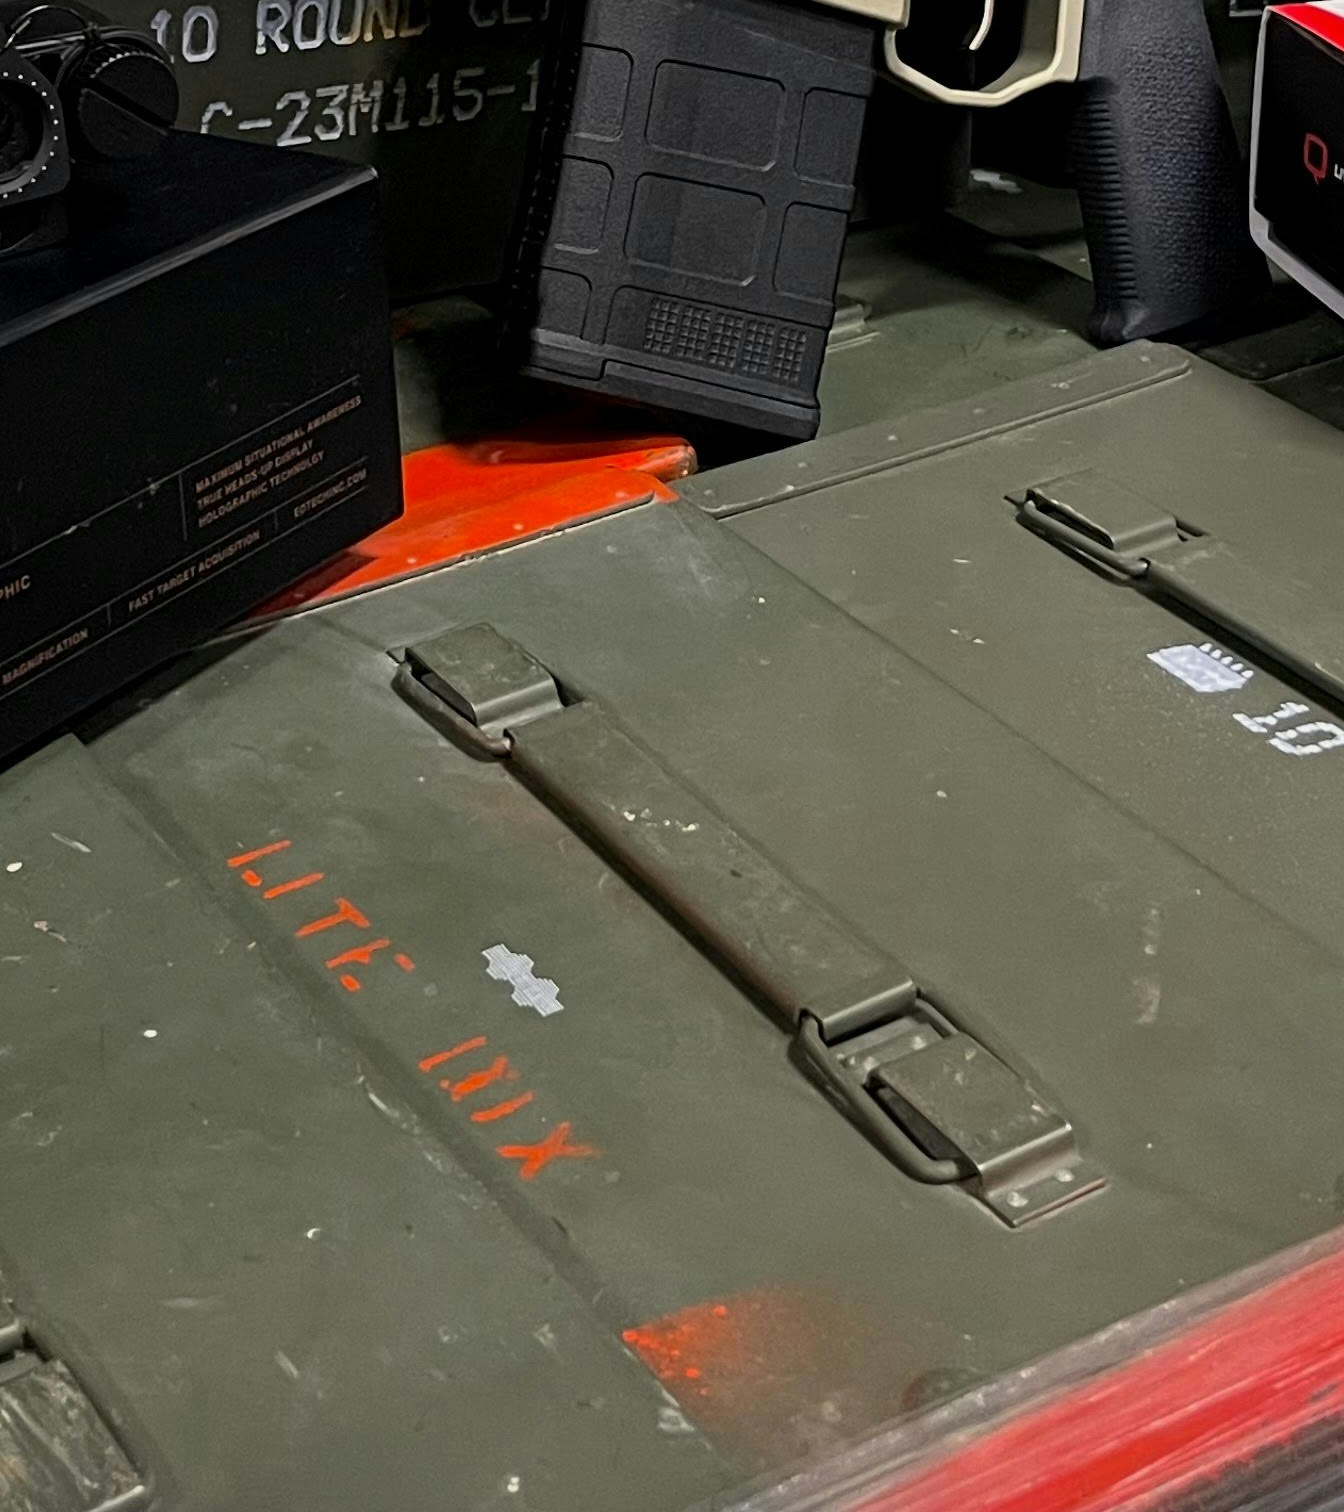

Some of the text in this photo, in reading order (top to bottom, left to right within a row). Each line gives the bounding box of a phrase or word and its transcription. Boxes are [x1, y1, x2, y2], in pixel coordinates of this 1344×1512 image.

[198, 480, 268, 529] HOLOGRAPHIC
[127, 529, 261, 614] FAST TARGET ACQUISITION
[2, 627, 90, 687] MAGNIFICATION
